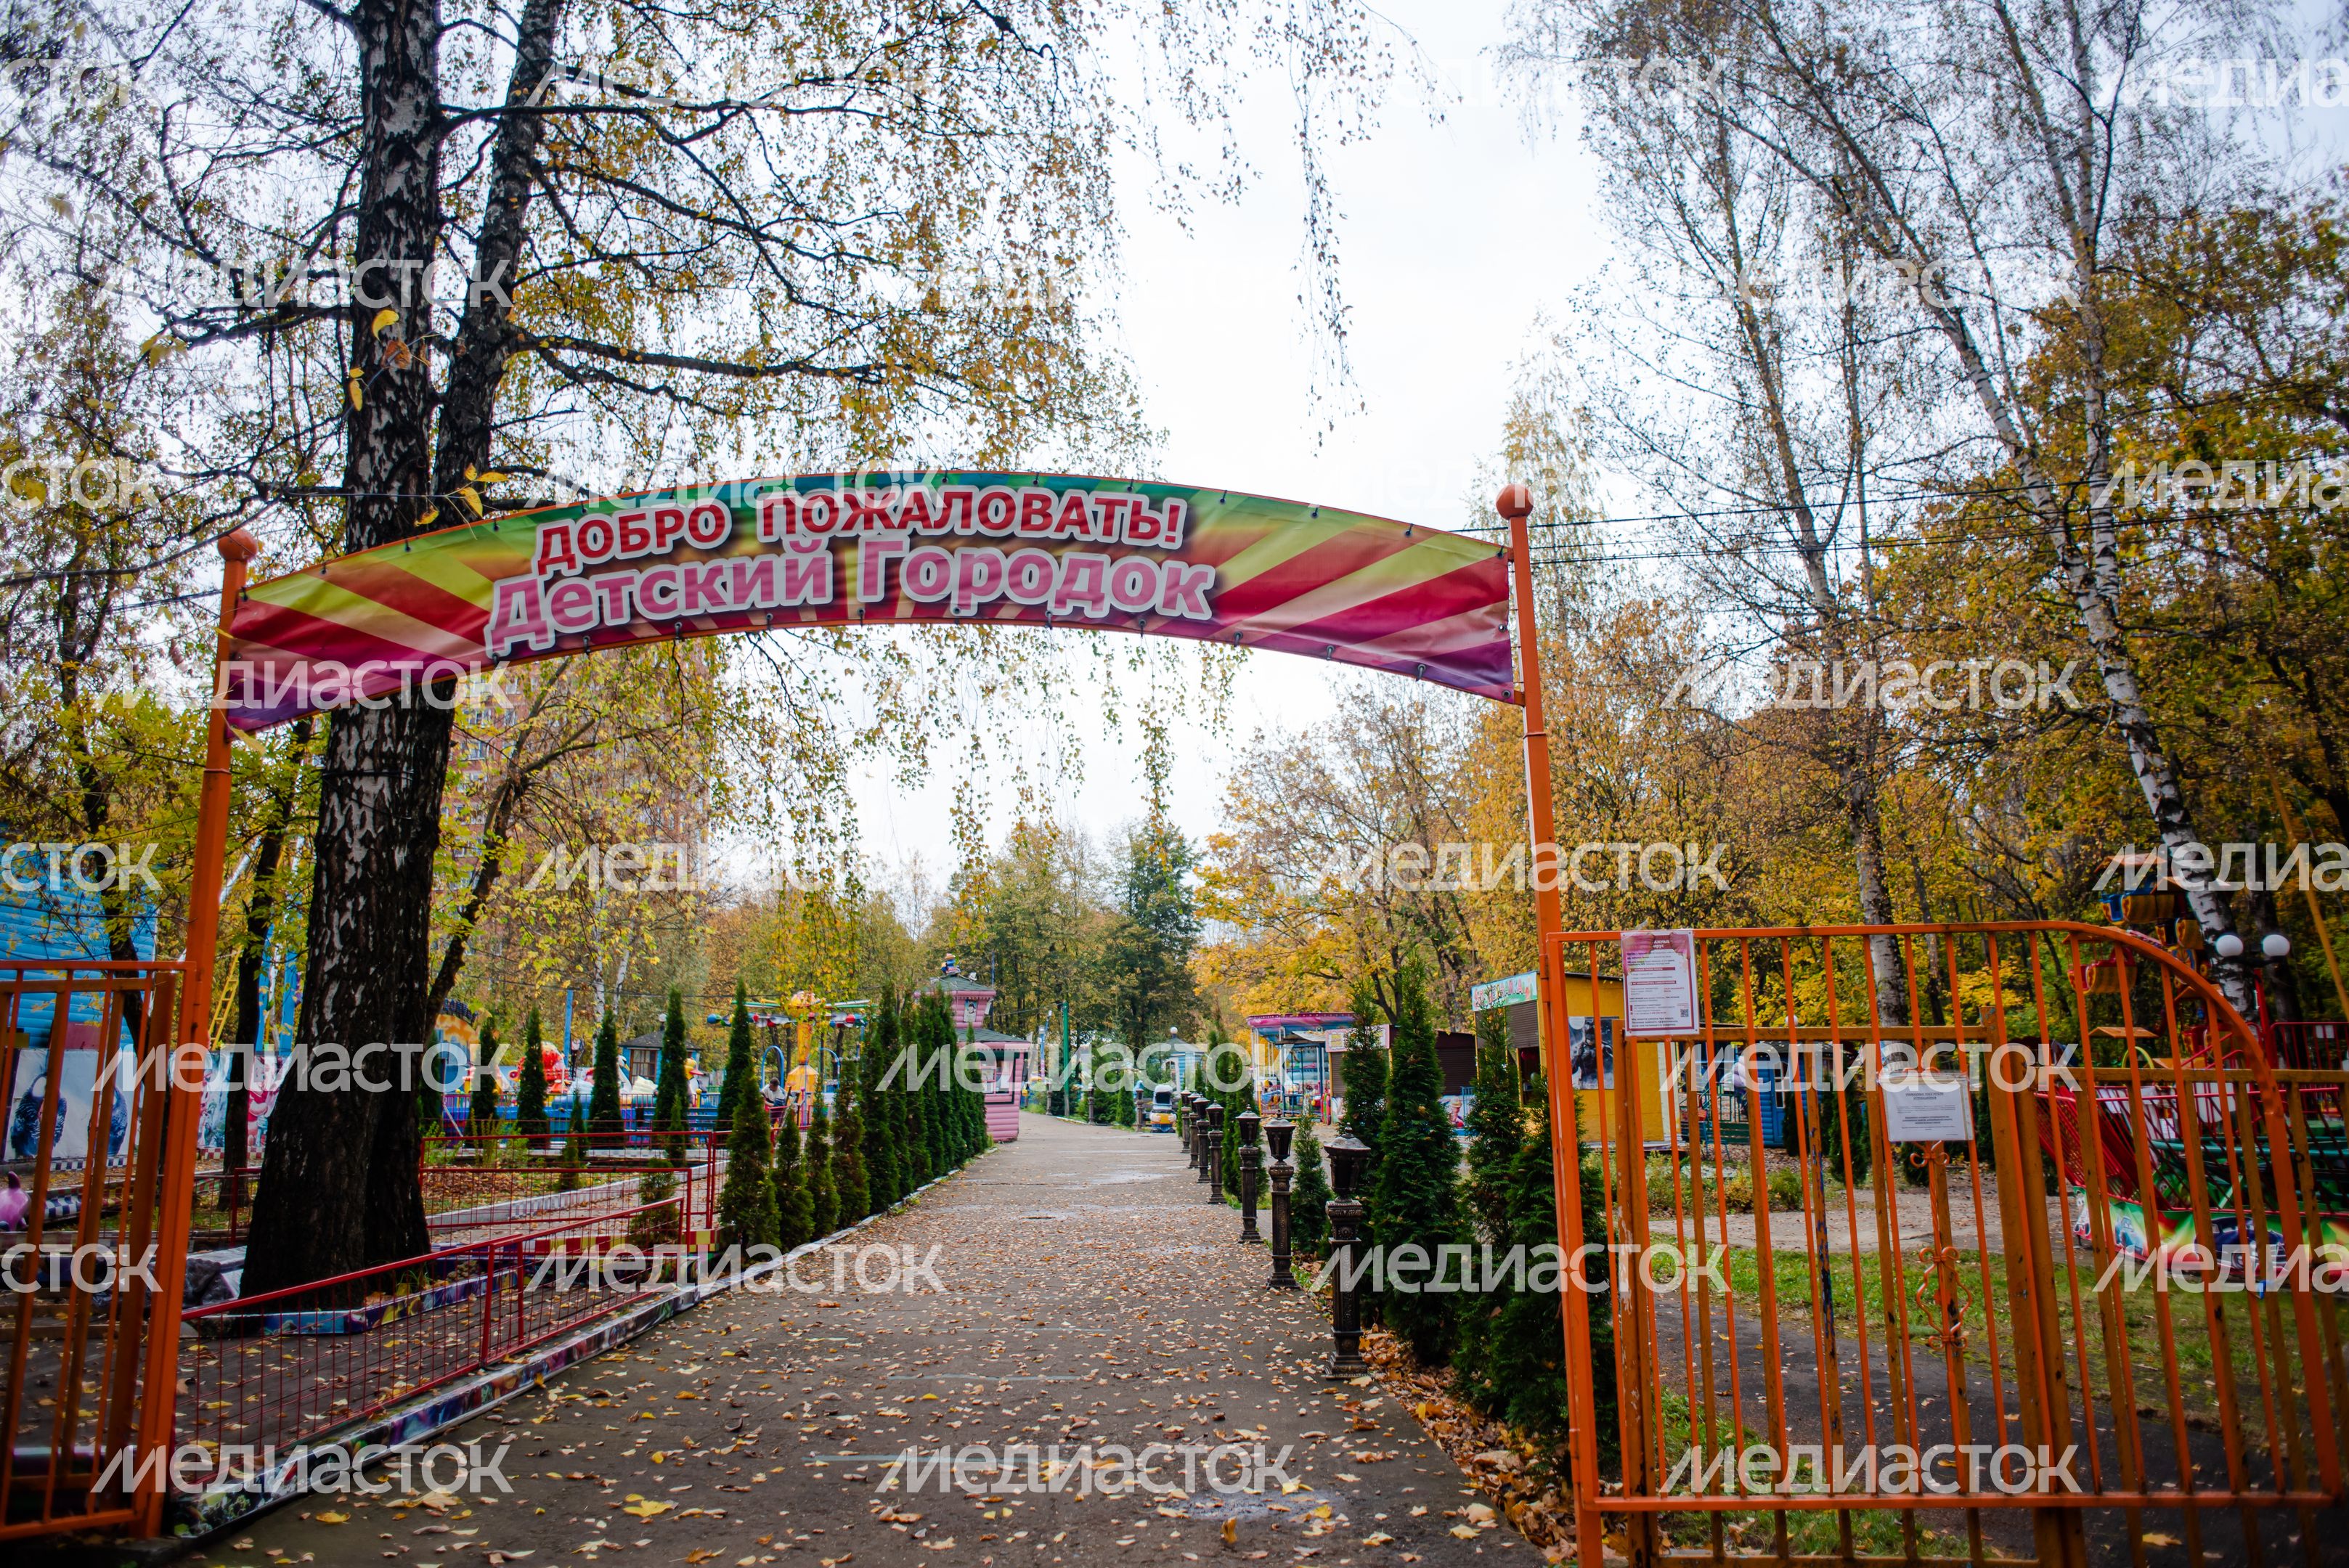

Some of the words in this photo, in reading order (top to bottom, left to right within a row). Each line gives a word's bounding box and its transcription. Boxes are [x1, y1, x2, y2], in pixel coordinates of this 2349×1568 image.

[536, 500, 729, 577] ДОБРО
[760, 488, 1183, 546] ПОЖАЛОВАТЬ!
[488, 538, 830, 653] Детский
[860, 538, 1212, 617] Городок
